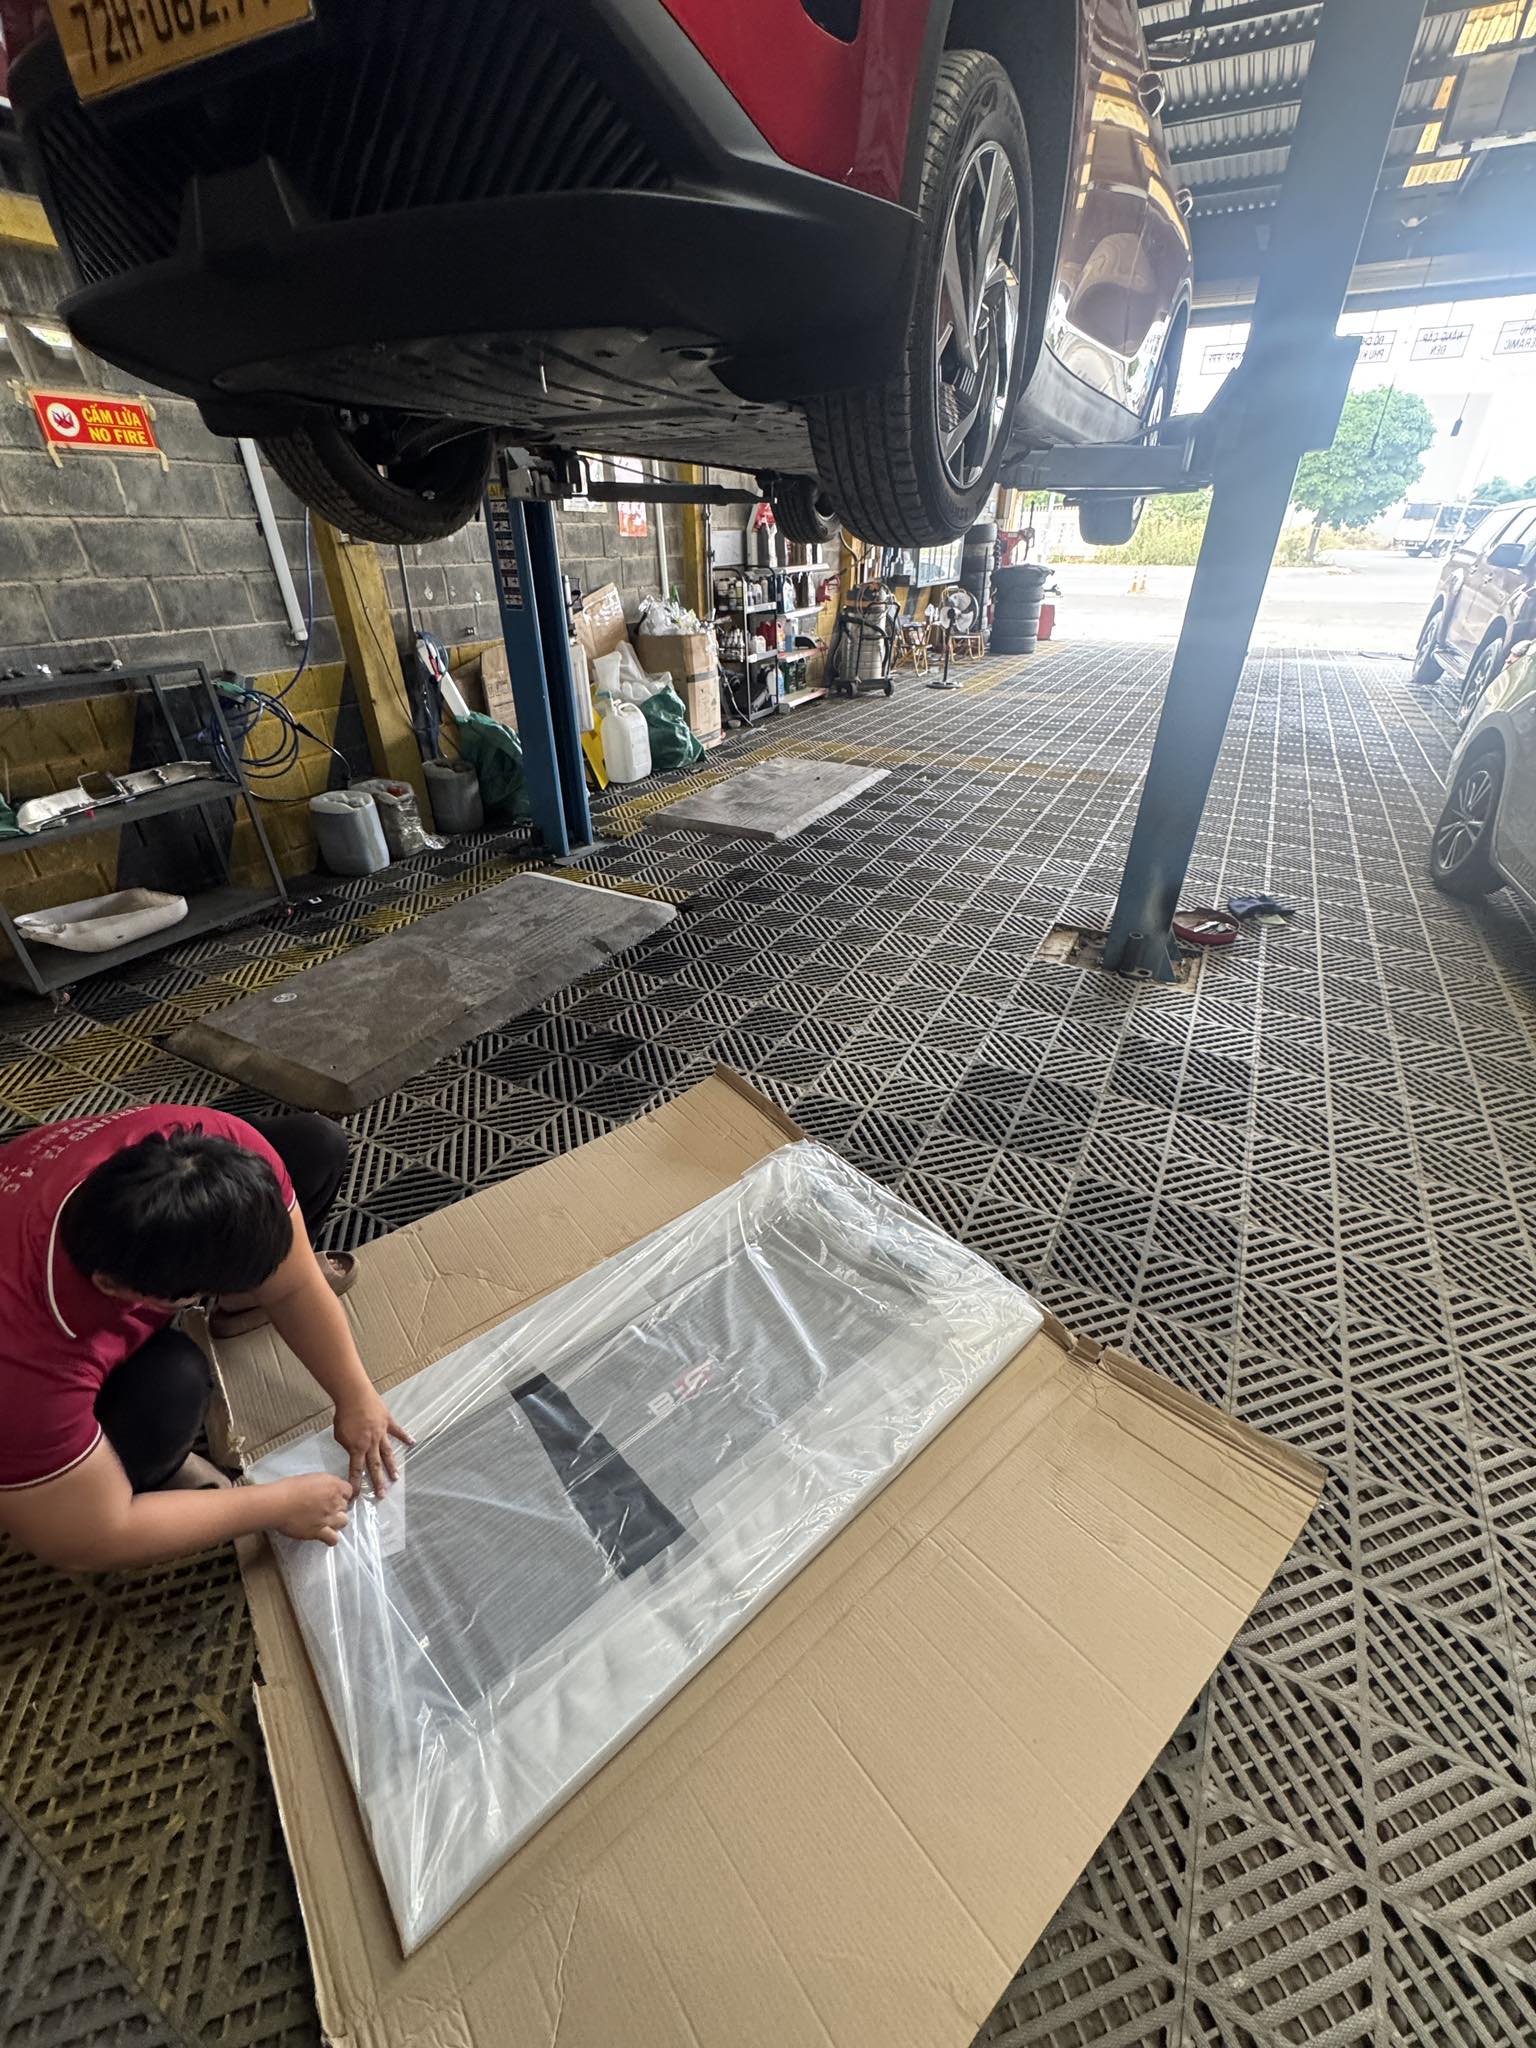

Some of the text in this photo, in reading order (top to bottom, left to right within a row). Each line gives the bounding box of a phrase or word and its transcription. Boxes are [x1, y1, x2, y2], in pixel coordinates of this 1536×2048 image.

[81, 403, 142, 427] CẤM LỬA
[87, 426, 148, 445] NO FIRE
